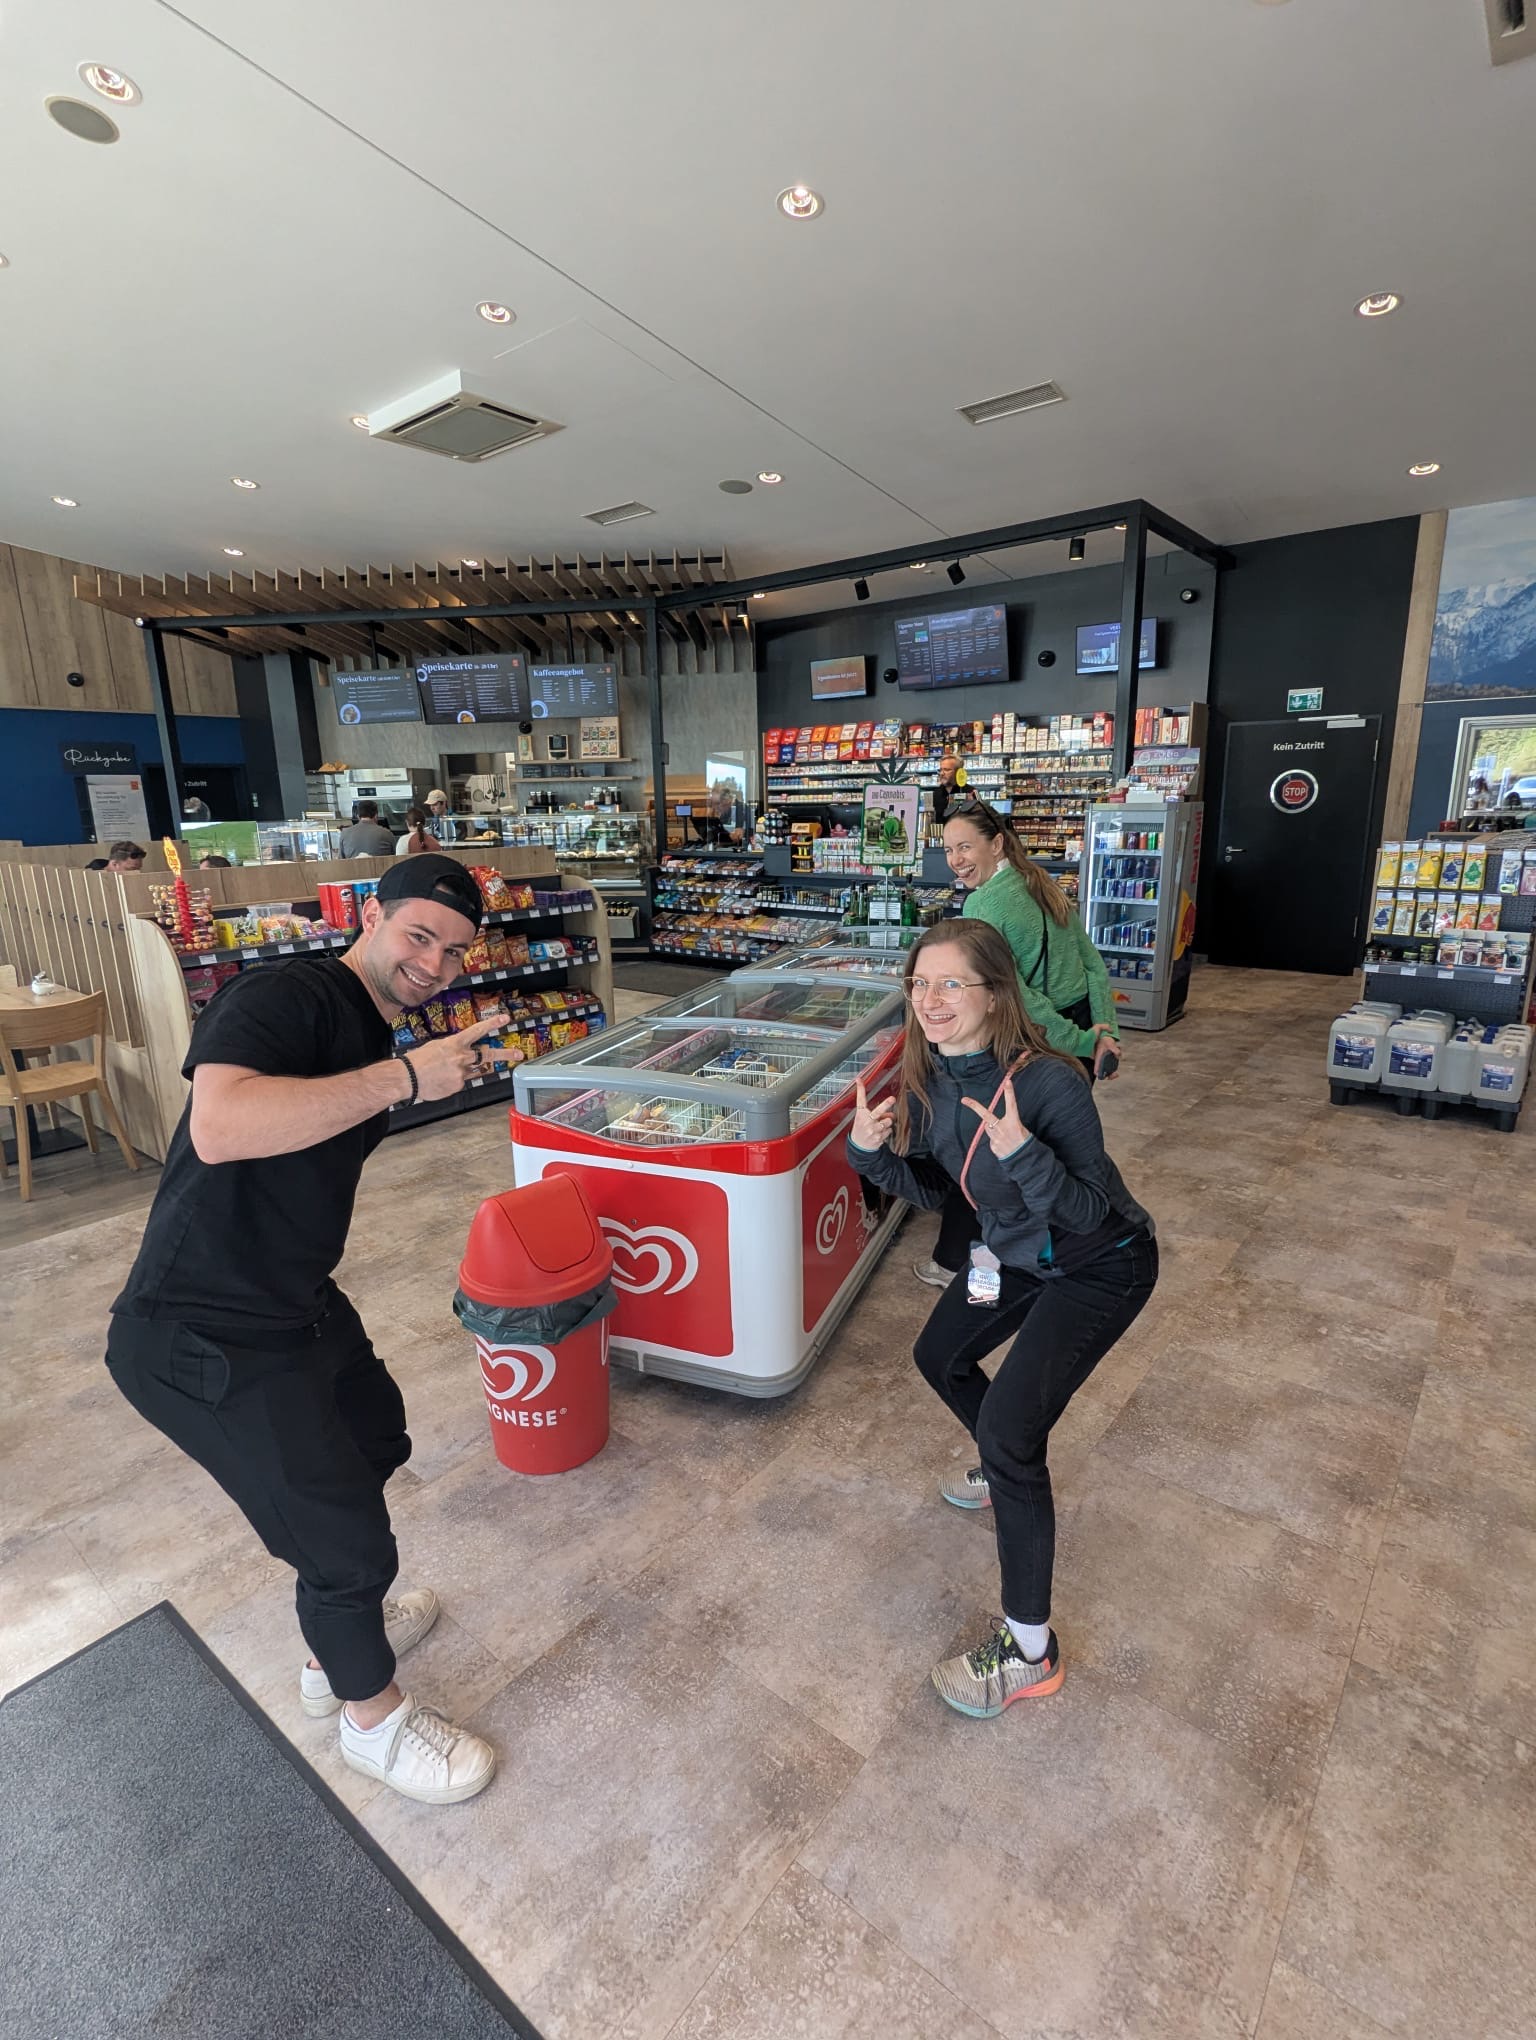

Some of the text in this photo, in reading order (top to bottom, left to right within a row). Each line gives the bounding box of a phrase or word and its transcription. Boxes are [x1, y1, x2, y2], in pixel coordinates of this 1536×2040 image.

[421, 662, 473, 674] Speisekarte
[533, 668, 584, 677] Kaffeeangebot
[337, 675, 377, 685] Speisekarte
[1273, 741, 1326, 751] Kein Zutritt
[64, 749, 132, 767] Rückgabe
[879, 789, 905, 800] Cannabis
[1285, 787, 1306, 796] STOP
